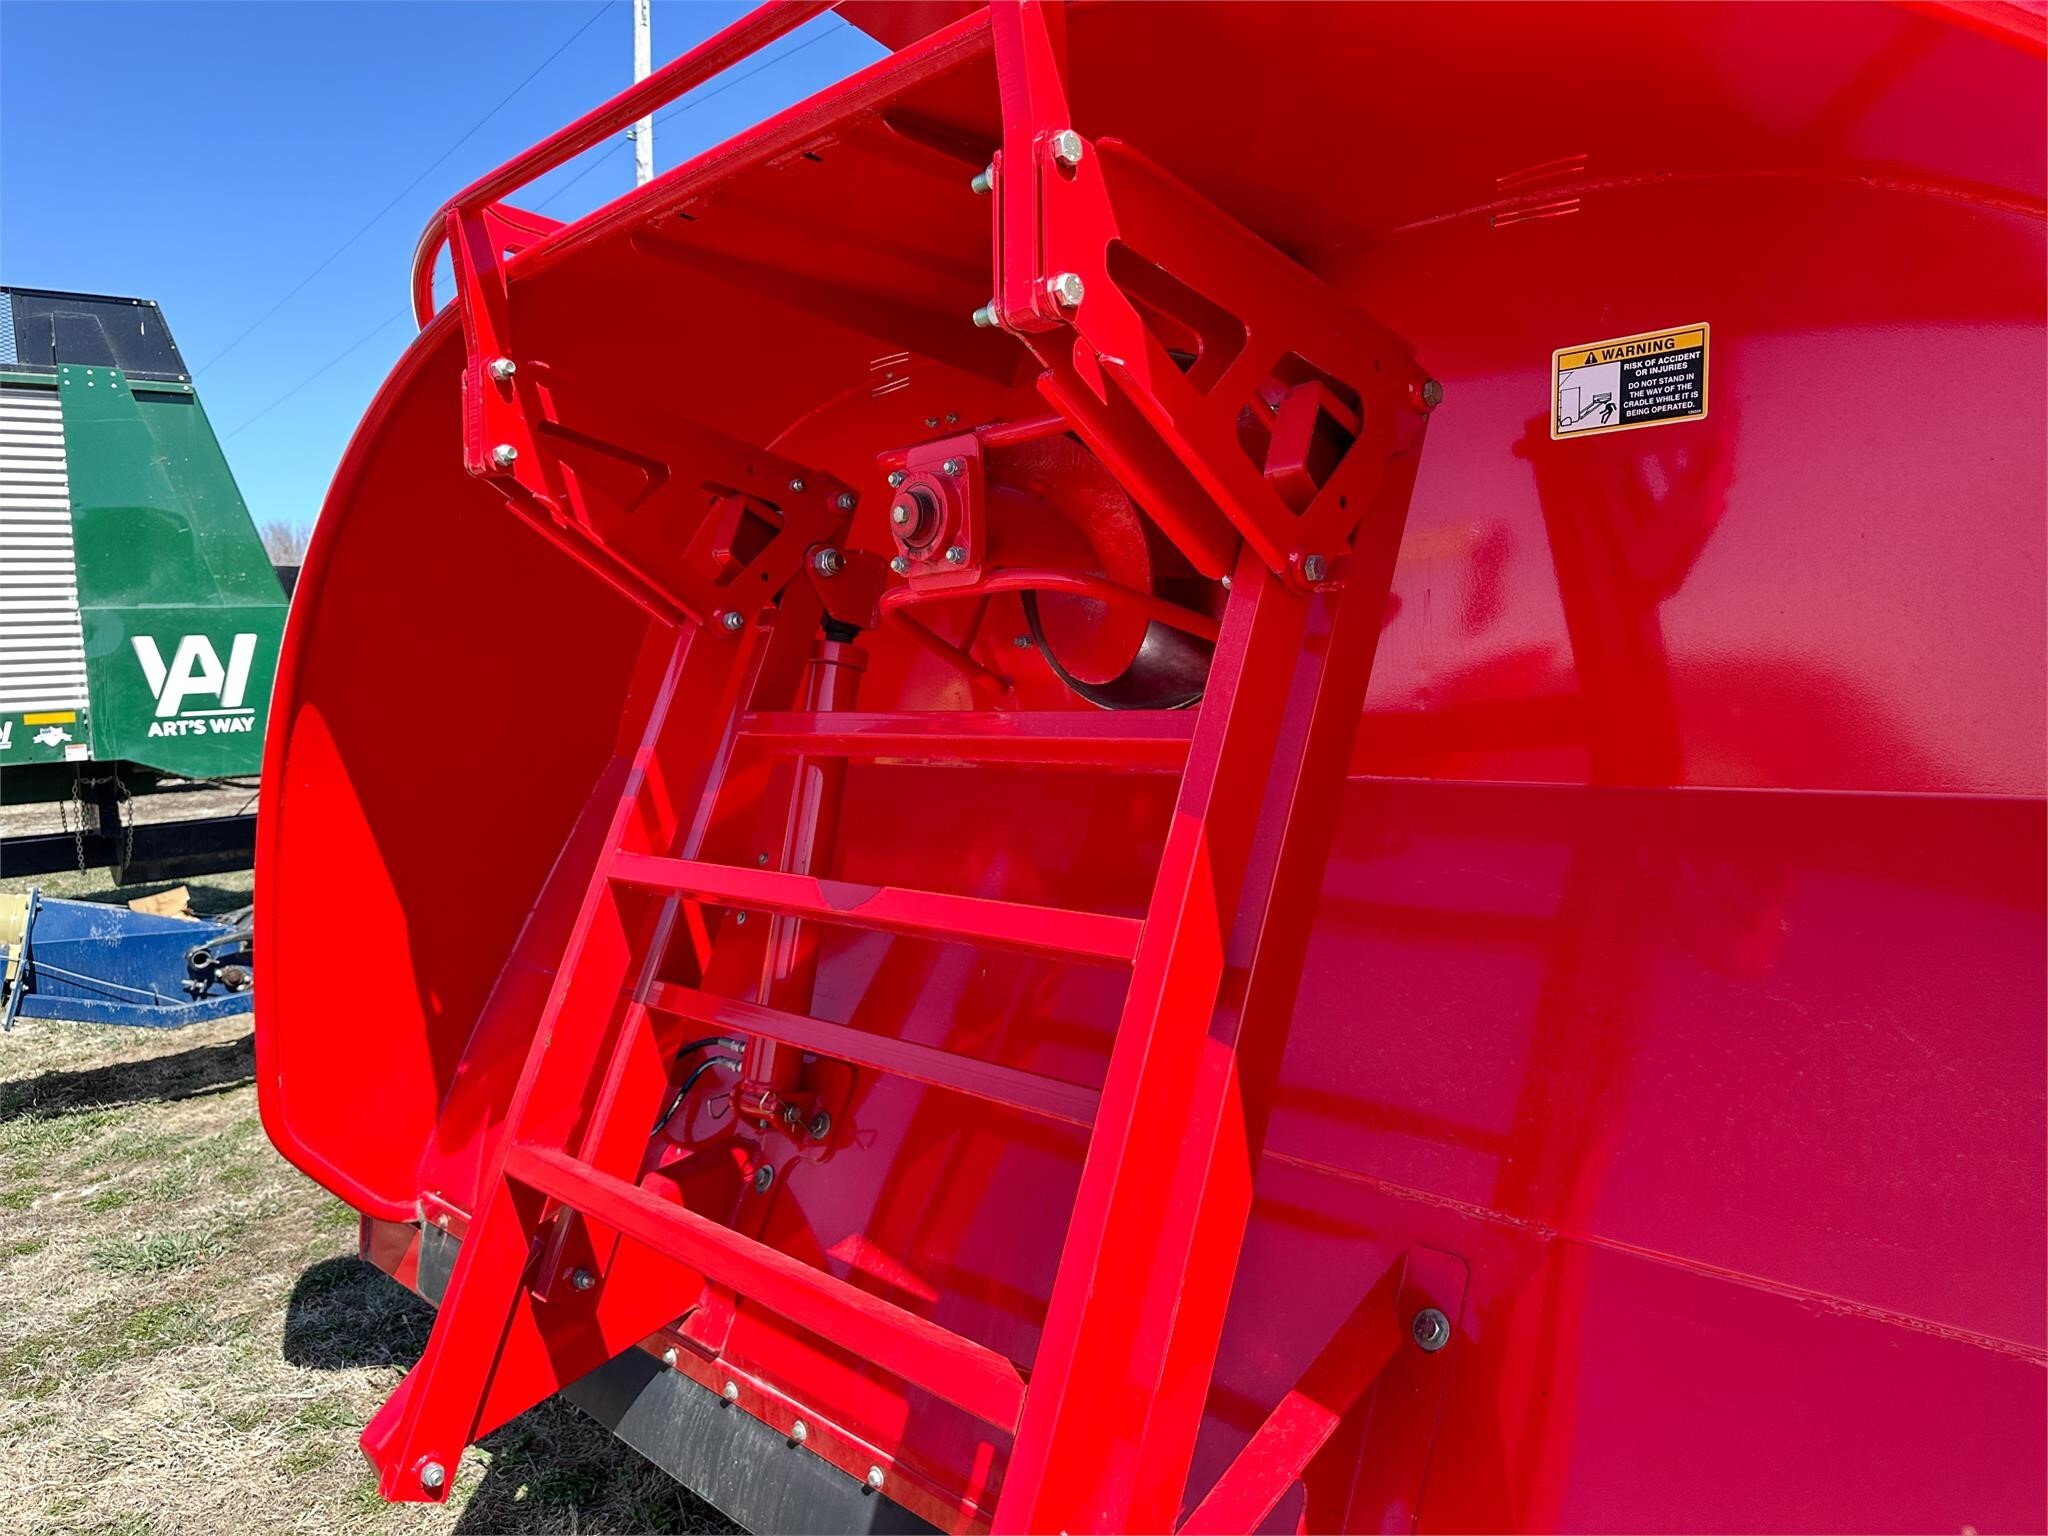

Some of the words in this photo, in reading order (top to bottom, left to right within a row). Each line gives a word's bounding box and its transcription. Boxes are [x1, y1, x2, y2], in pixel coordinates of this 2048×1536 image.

[1602, 338, 1675, 361] WARNING
[1623, 361, 1643, 371] RISK
[1644, 359, 1656, 367] OF
[1657, 351, 1701, 365] ACCIDENT
[1635, 369, 1648, 377] OR
[1649, 361, 1688, 375] INJURIES
[1628, 381, 1640, 390] DO
[1641, 378, 1657, 387] NOT
[1658, 374, 1685, 385] STAND
[1629, 390, 1645, 398] THE
[1646, 387, 1663, 396] WAY
[1664, 385, 1675, 393] OF
[1676, 382, 1693, 391] THE
[1623, 397, 1654, 408] CRADLE
[1655, 393, 1680, 403] WHILE
[1682, 392, 1689, 400] IT
[1626, 407, 1650, 417] BEING
[1651, 401, 1695, 413] OPERATED.
[147, 719, 207, 738] ART'S
[209, 716, 255, 734] WAY
